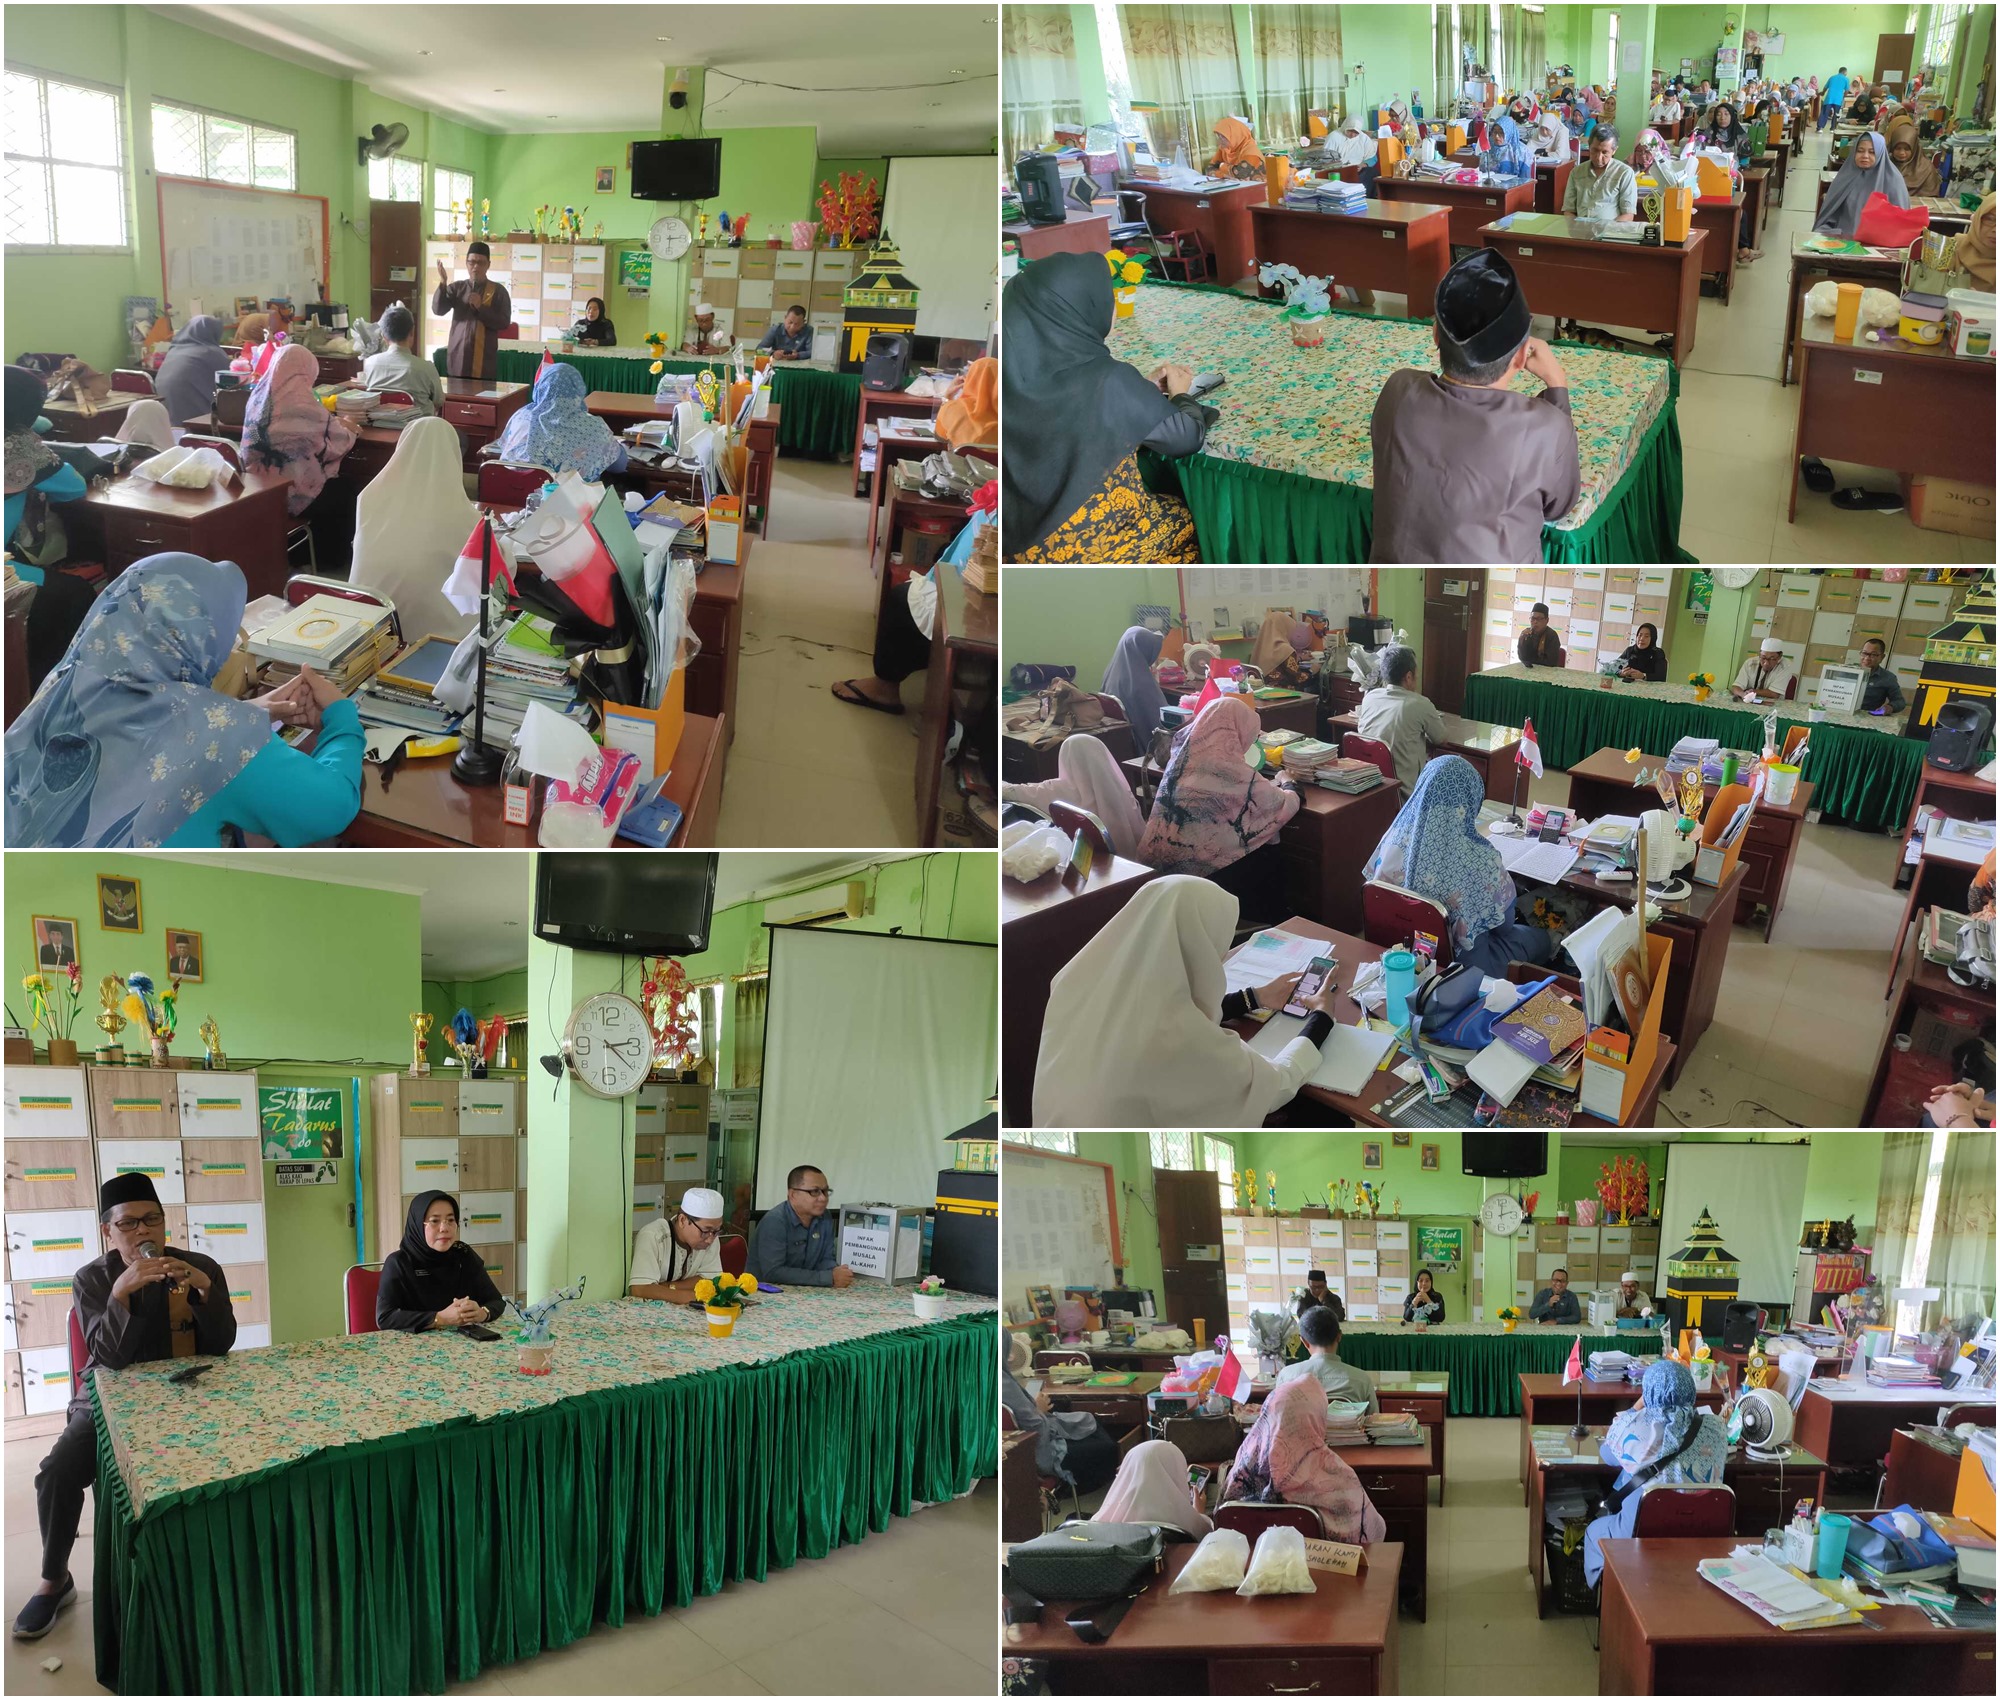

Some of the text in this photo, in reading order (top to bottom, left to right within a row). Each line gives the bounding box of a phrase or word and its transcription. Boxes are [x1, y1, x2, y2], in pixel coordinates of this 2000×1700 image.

[666, 222, 677, 230] 12
[591, 1012, 598, 1021] 11
[598, 1006, 620, 1026] 12
[581, 1022, 592, 1032] 10
[629, 1023, 636, 1032] 2
[575, 1036, 591, 1056] 9
[627, 1037, 641, 1056] 3
[581, 1060, 589, 1069] 8
[591, 1071, 598, 1080] 7
[602, 1066, 617, 1086] 6
[620, 1072, 628, 1080] 5
[261, 1091, 333, 1113] Shalat
[262, 1113, 337, 1133] Tadarus
[1422, 1228, 1457, 1239] Shalat
[844, 1241, 886, 1252] PEMBANGUNAN
[852, 1251, 876, 1260] MUSALA
[850, 1260, 877, 1270] AL-KAHFI
